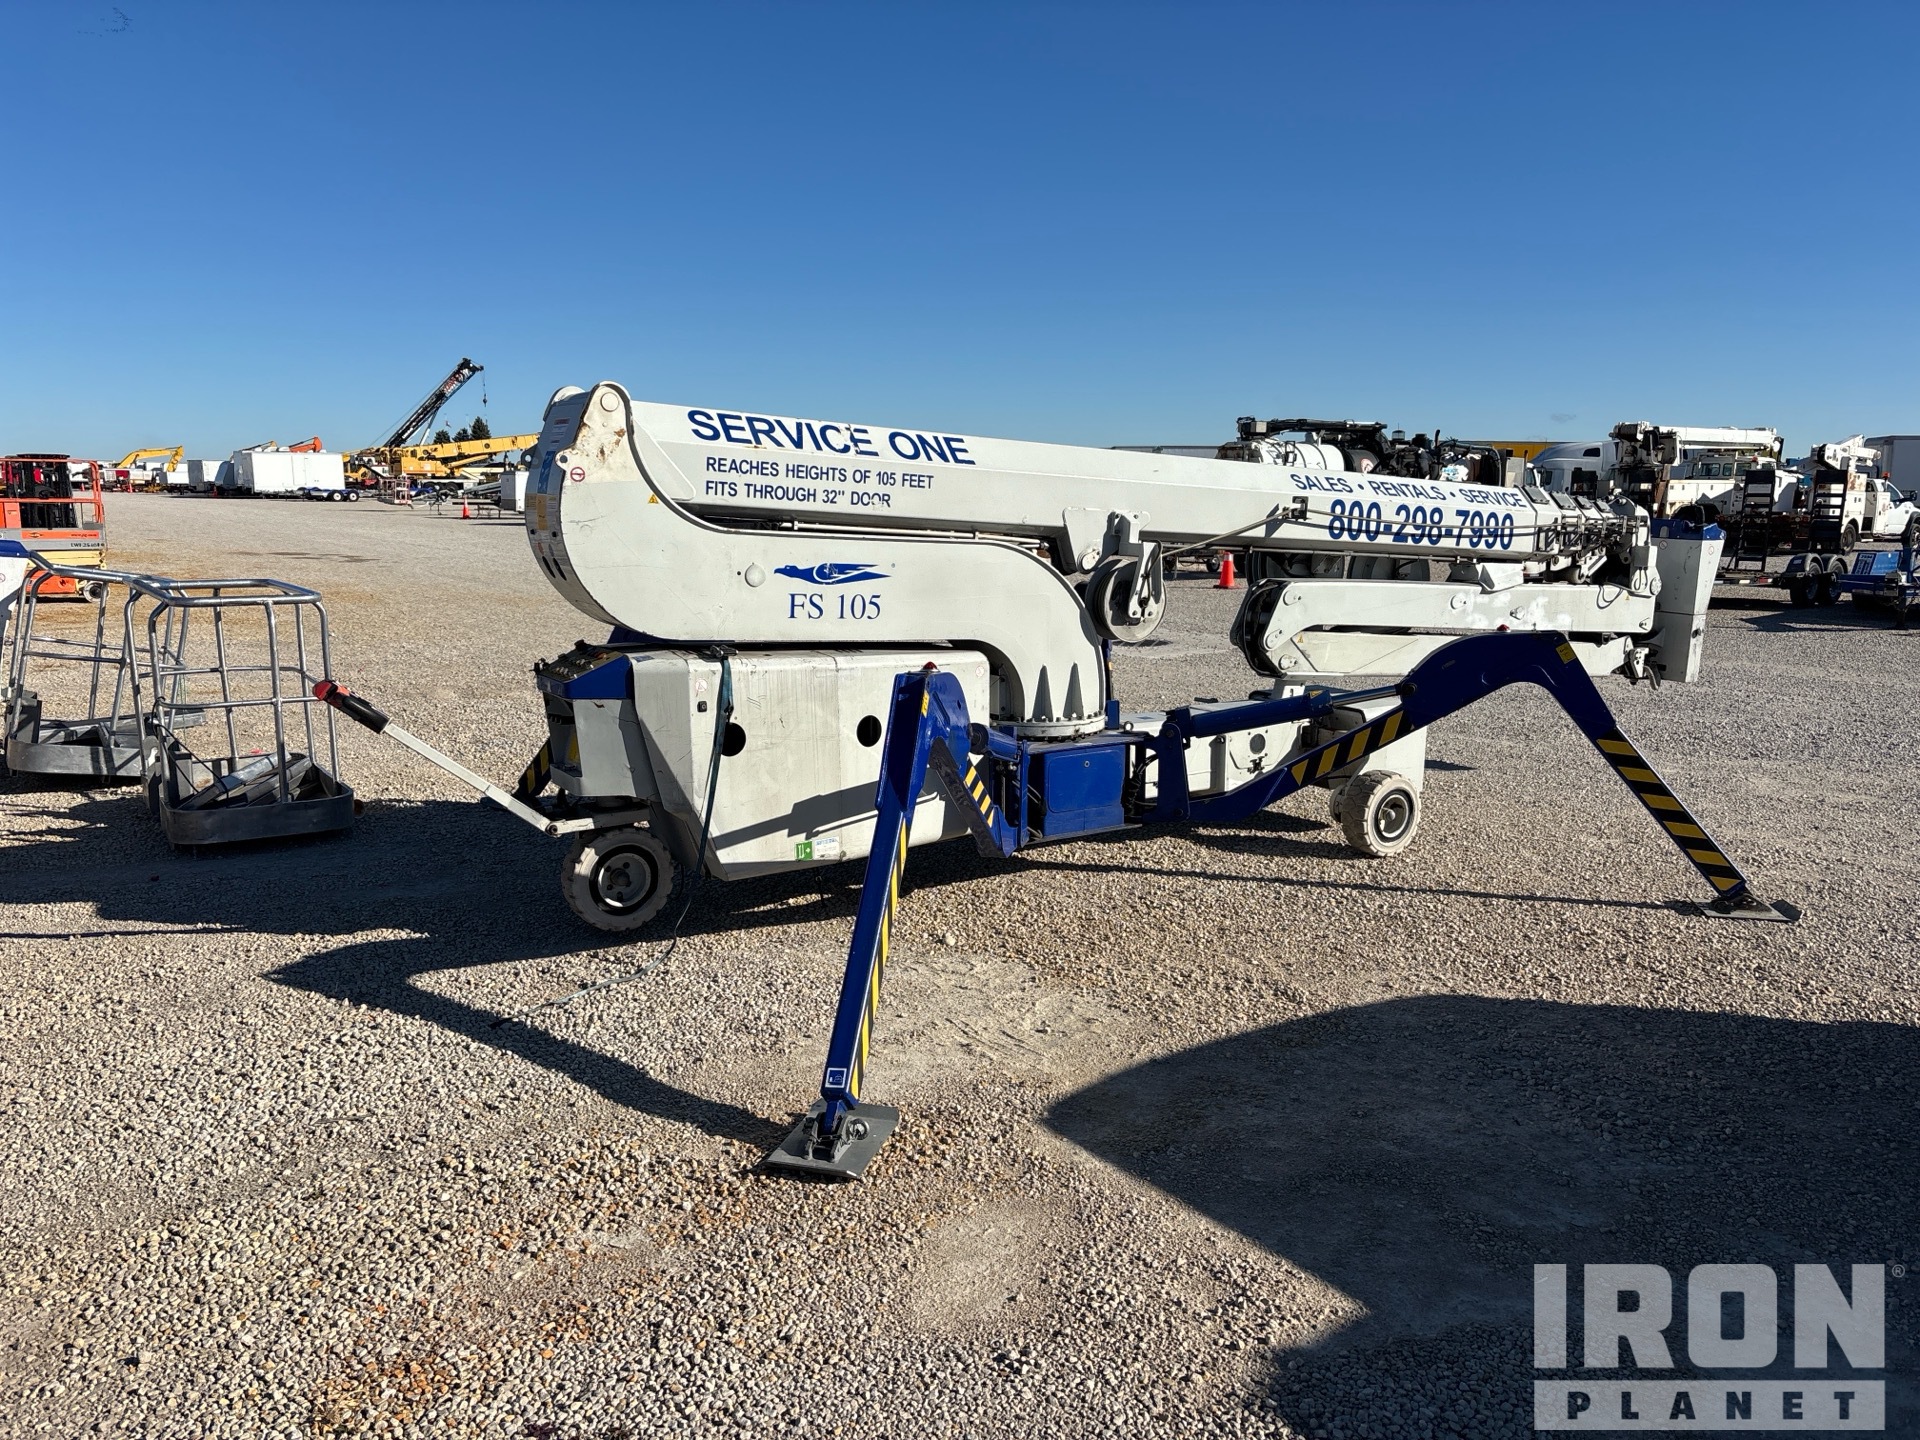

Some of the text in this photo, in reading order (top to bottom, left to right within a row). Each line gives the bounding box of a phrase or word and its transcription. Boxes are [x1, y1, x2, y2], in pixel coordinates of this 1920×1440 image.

[687, 409, 976, 466] SERVICE ONE
[705, 456, 934, 490] REACHES HEIGHTS OF 105 FEET
[705, 480, 891, 508] FITS THROUGH 32" DOOR
[1289, 473, 1528, 508] SALES RENTALS SERVICE
[1328, 498, 1514, 550] 800-298-7990
[788, 593, 882, 620] FS 105
